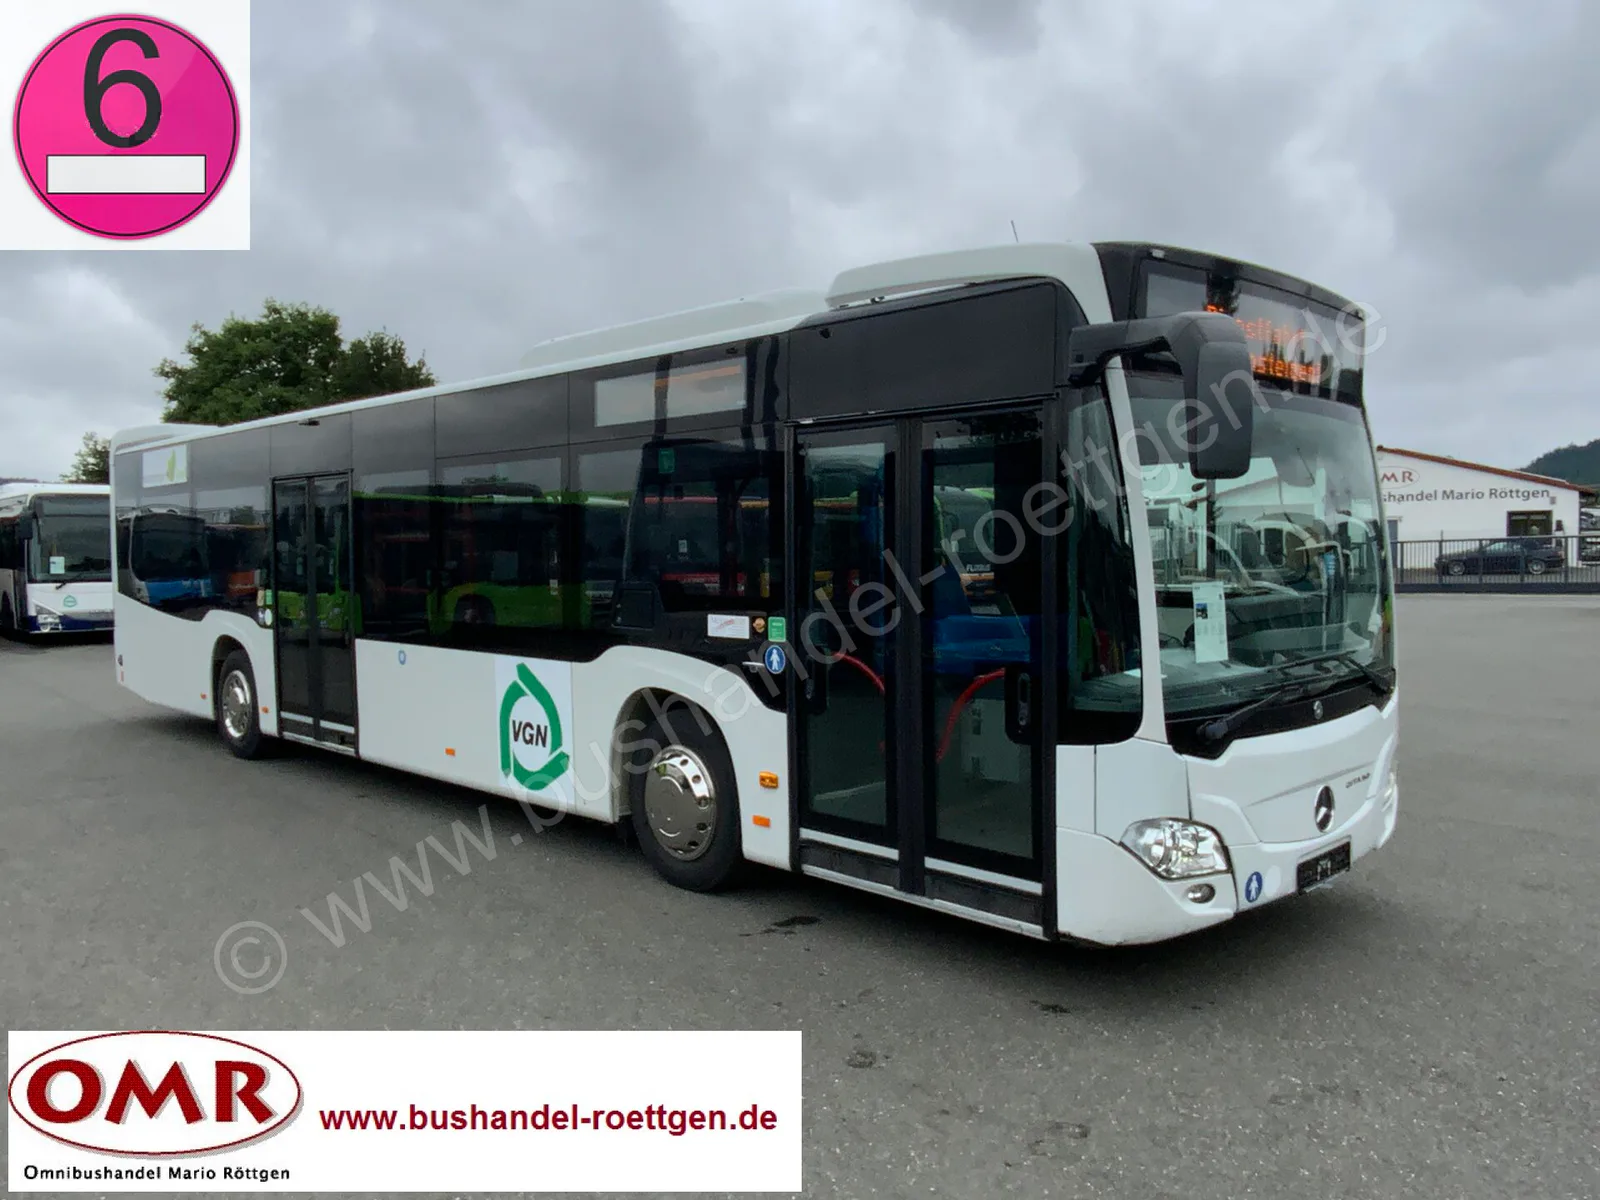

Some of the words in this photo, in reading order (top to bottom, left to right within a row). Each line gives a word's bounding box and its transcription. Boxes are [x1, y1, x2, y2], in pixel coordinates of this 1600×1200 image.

[1380, 470, 1414, 483] MR
[1442, 489, 1485, 501] Mario
[1489, 487, 1550, 502] Röttgen
[512, 719, 549, 748] VGN
